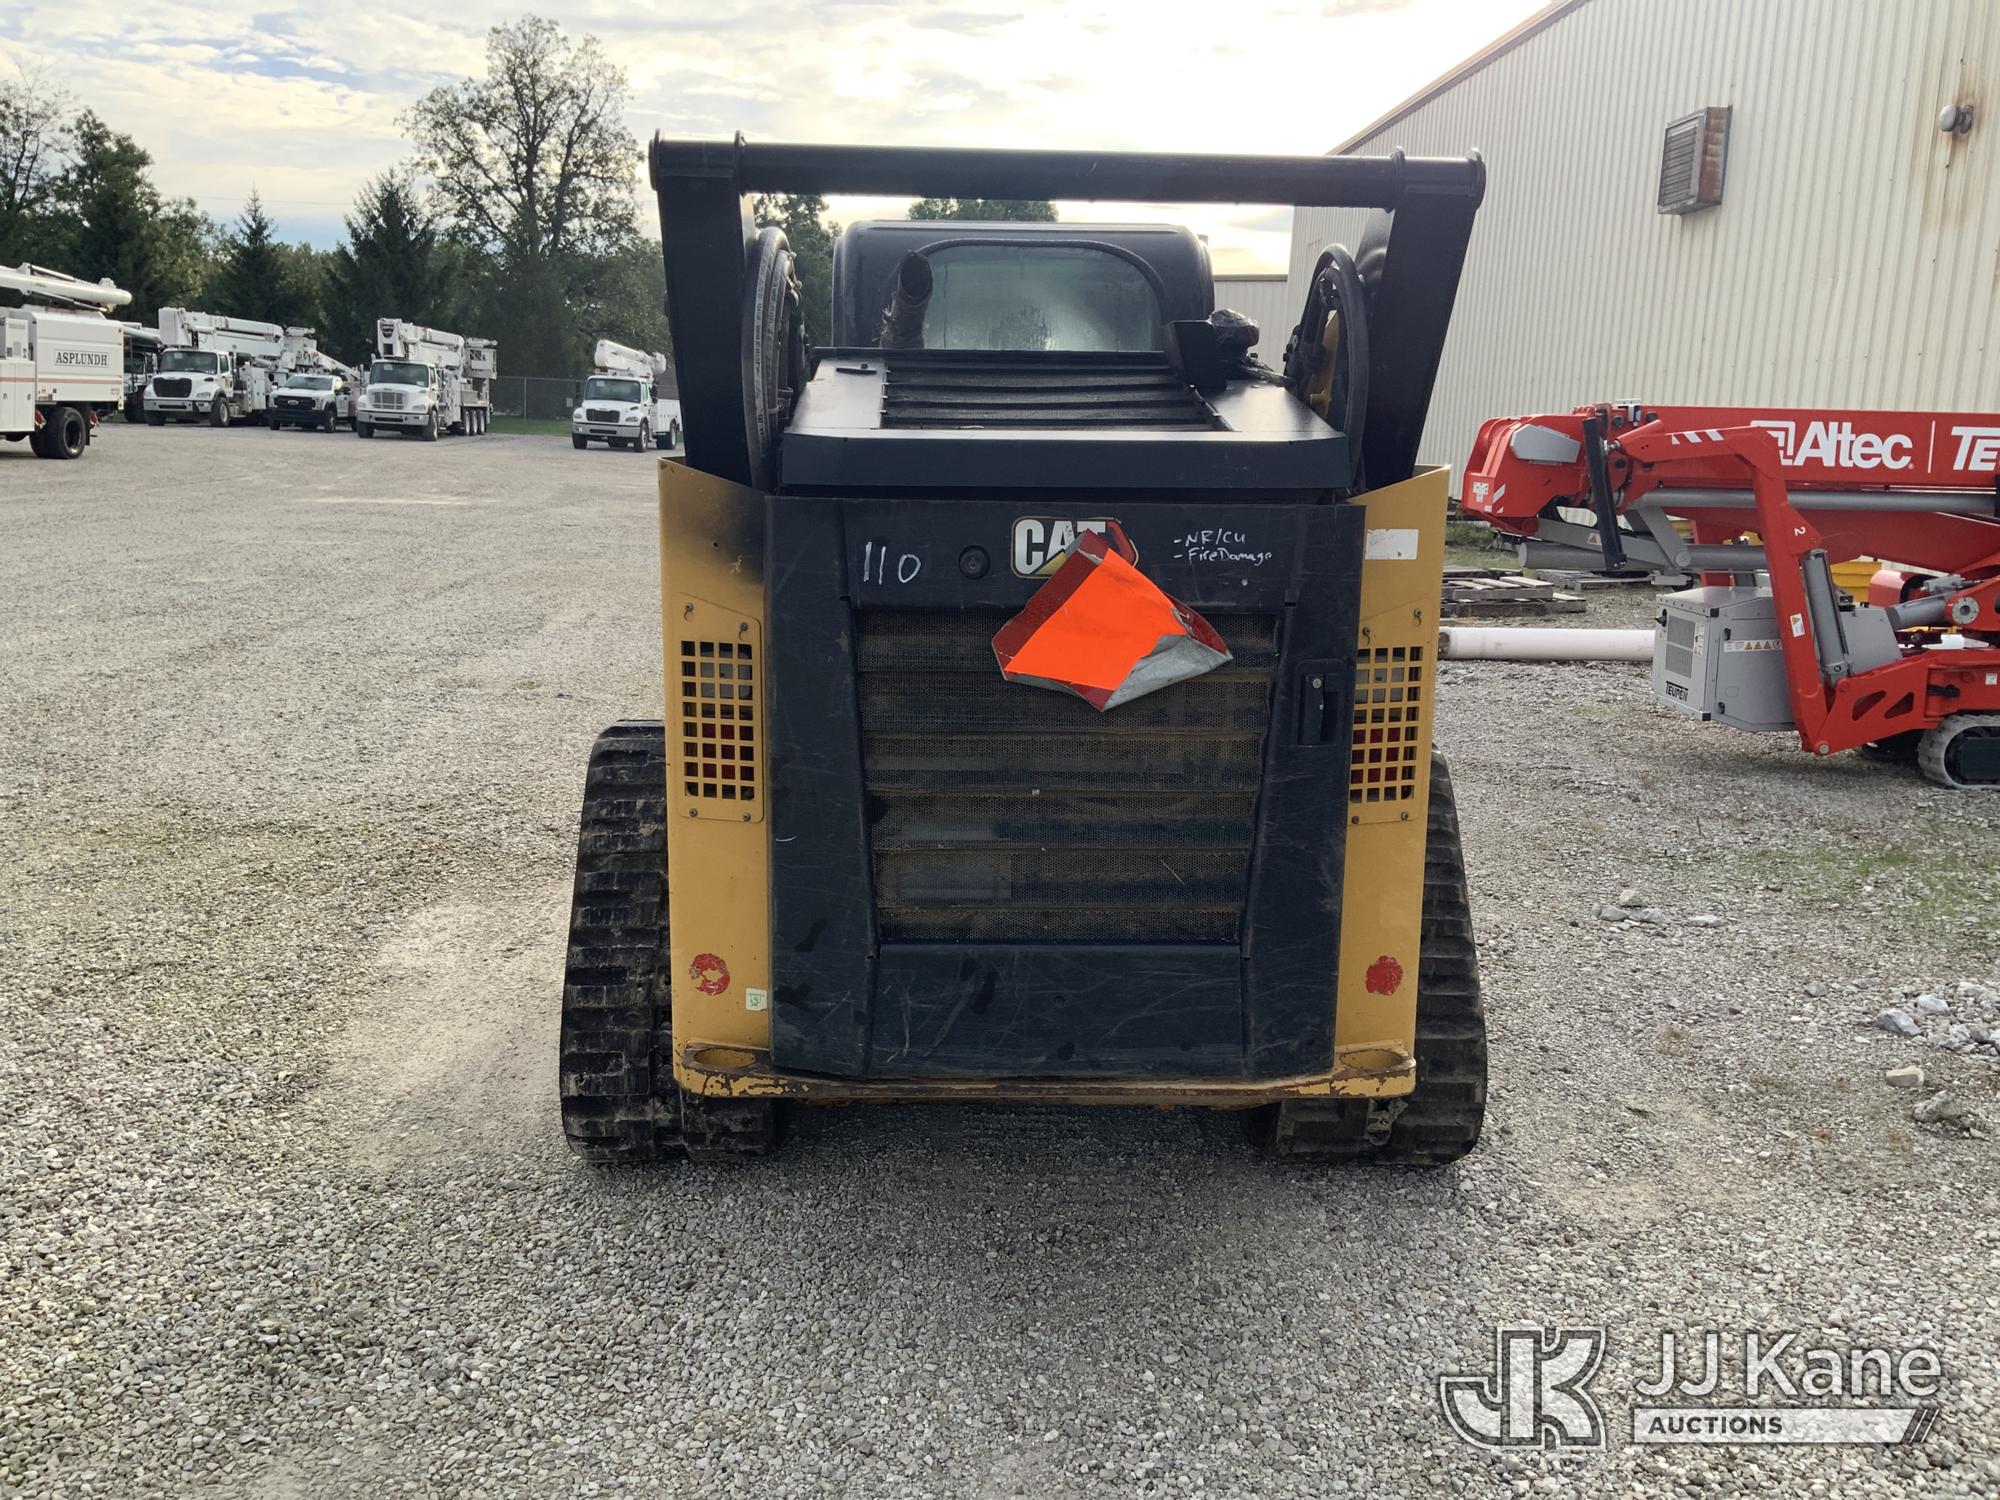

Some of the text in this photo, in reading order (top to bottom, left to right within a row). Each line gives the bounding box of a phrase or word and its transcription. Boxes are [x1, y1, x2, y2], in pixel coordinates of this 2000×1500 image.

[56, 351, 107, 366] ASPLUNDH
[1792, 420, 1914, 469] Altec
[863, 541, 922, 584] 110
[1665, 680, 1689, 702] TEUPEN
